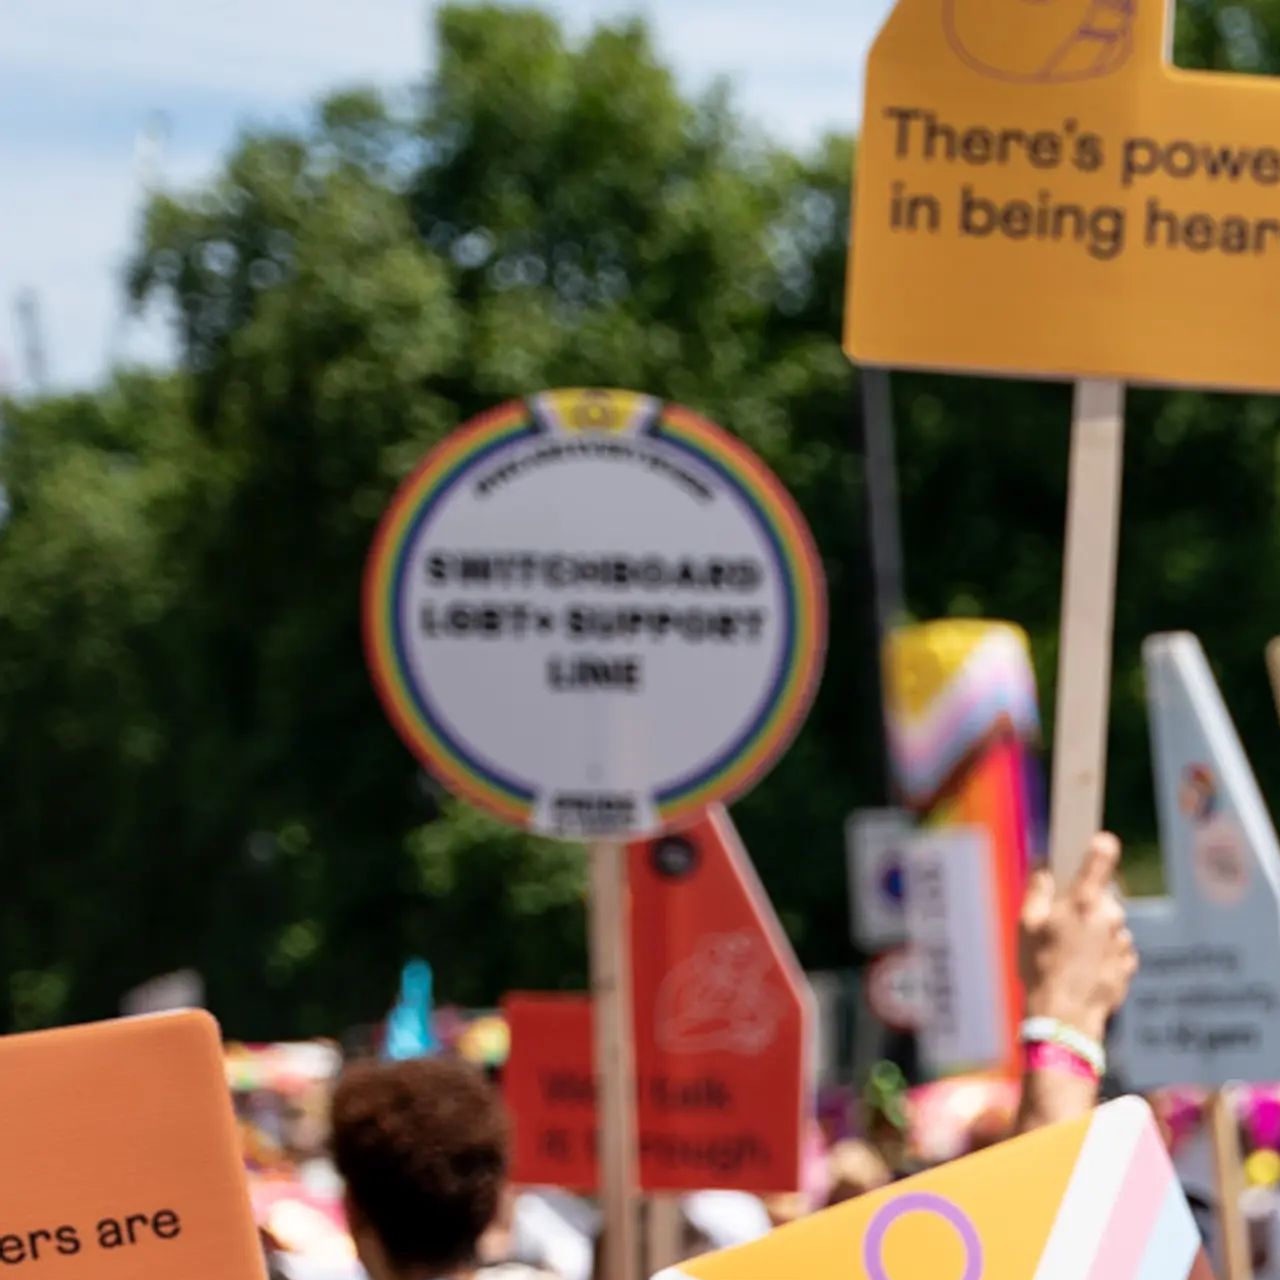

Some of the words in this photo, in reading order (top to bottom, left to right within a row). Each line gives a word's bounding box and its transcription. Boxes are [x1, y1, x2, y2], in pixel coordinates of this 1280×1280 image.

[882, 105, 1104, 174] There's
[889, 179, 941, 234] in
[958, 182, 1126, 263] being
[425, 550, 765, 591] SWITCHBOARD
[565, 603, 765, 644] SUPPORT
[546, 654, 643, 693] LINE
[97, 1209, 181, 1249] are
